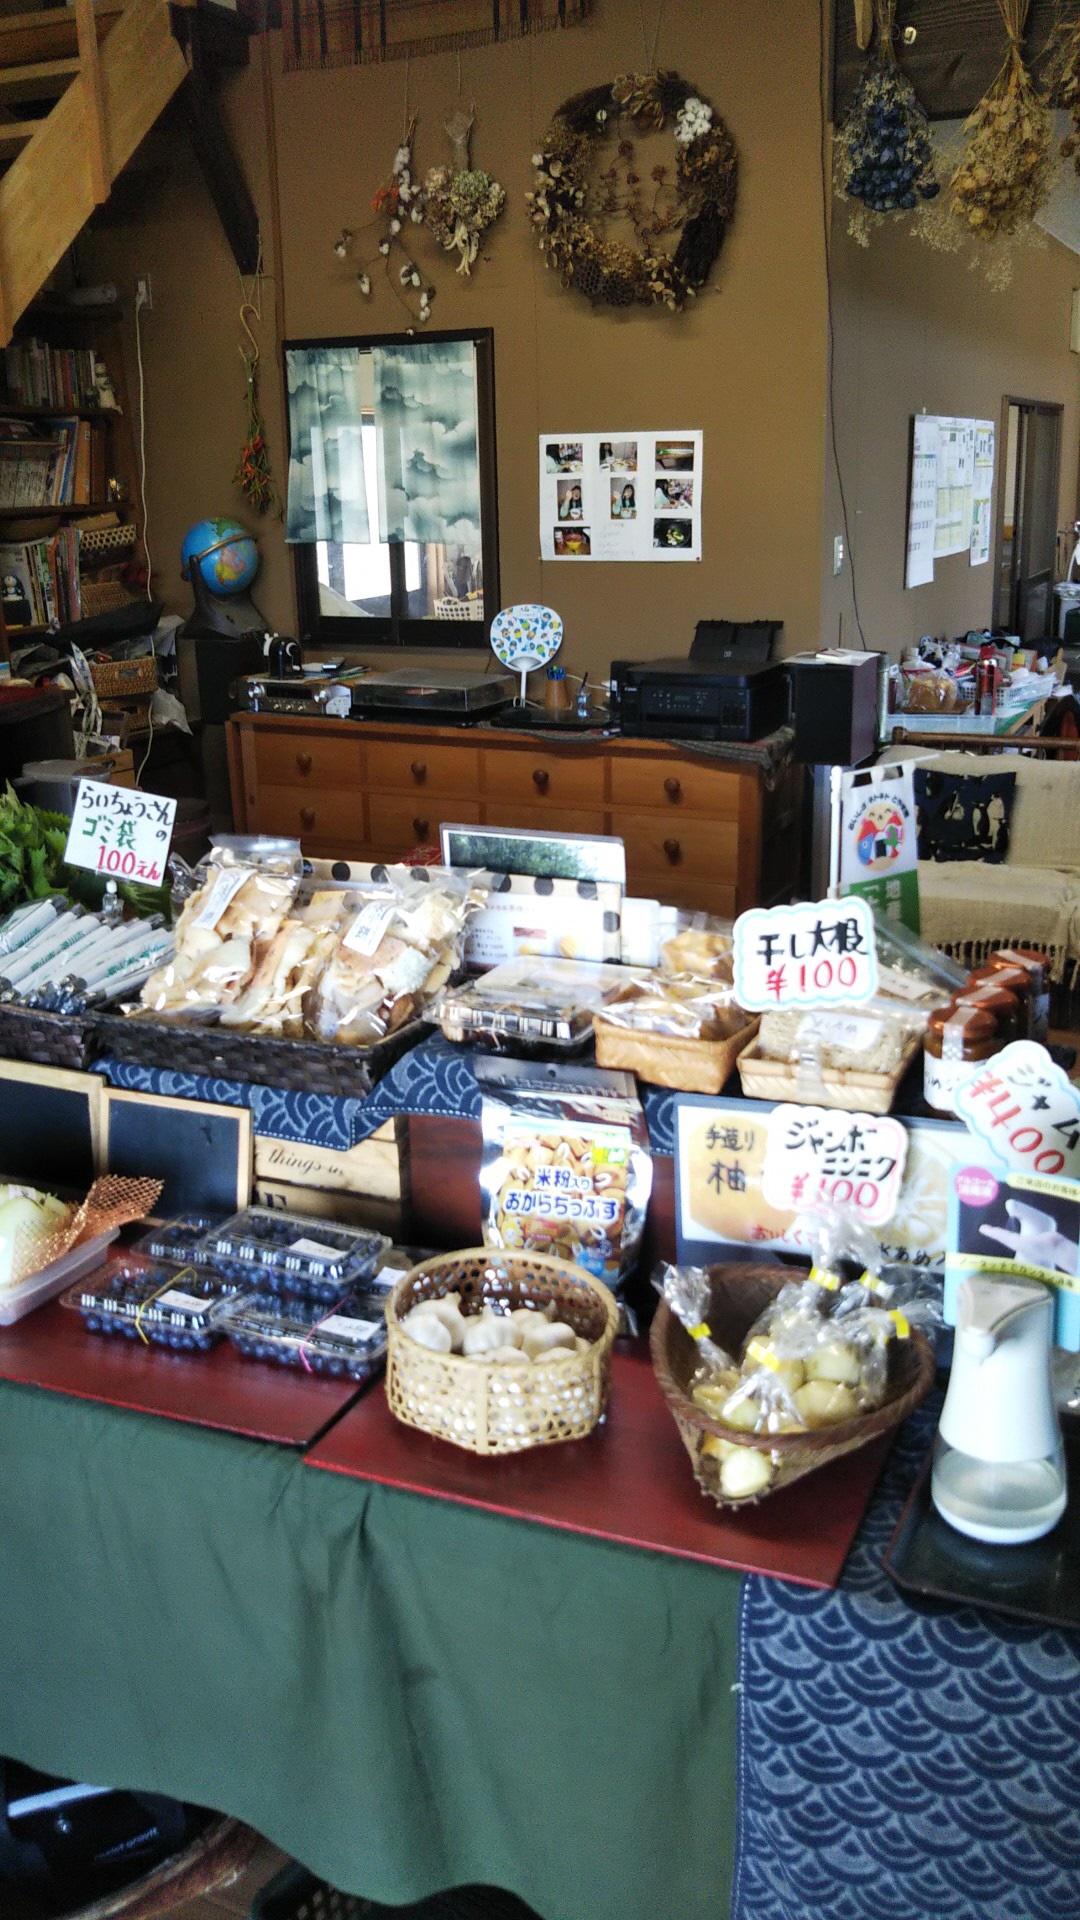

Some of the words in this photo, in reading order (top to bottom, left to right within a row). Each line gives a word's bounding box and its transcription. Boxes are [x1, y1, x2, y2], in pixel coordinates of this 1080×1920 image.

[81, 785, 173, 826] らいちょうさん
[82, 815, 137, 851] ゴミ袋
[155, 830, 167, 842] の
[97, 845, 161, 881] 100えん
[756, 917, 870, 966] 干し大根
[765, 956, 857, 1002] ¥100
[705, 1124, 757, 1151] 手造り
[970, 1070, 1065, 1175] ¥400
[267, 1148, 322, 1175] things
[536, 1168, 592, 1191] 米粉入り
[505, 1191, 618, 1220] おからちっぷす
